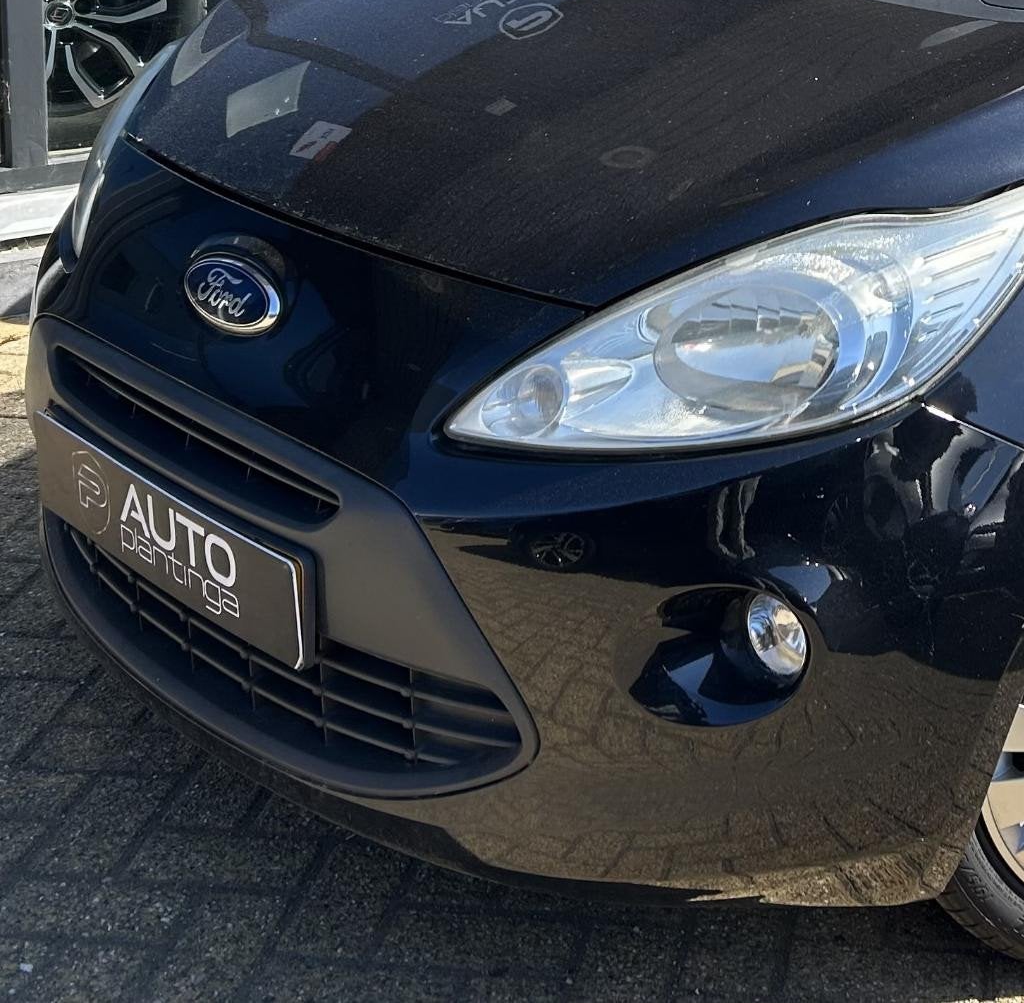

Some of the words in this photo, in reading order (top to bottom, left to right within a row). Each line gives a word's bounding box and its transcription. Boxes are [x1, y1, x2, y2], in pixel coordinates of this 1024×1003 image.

[197, 267, 248, 317] Ford
[120, 524, 240, 618] plantinga
[121, 483, 237, 588] AUTO
